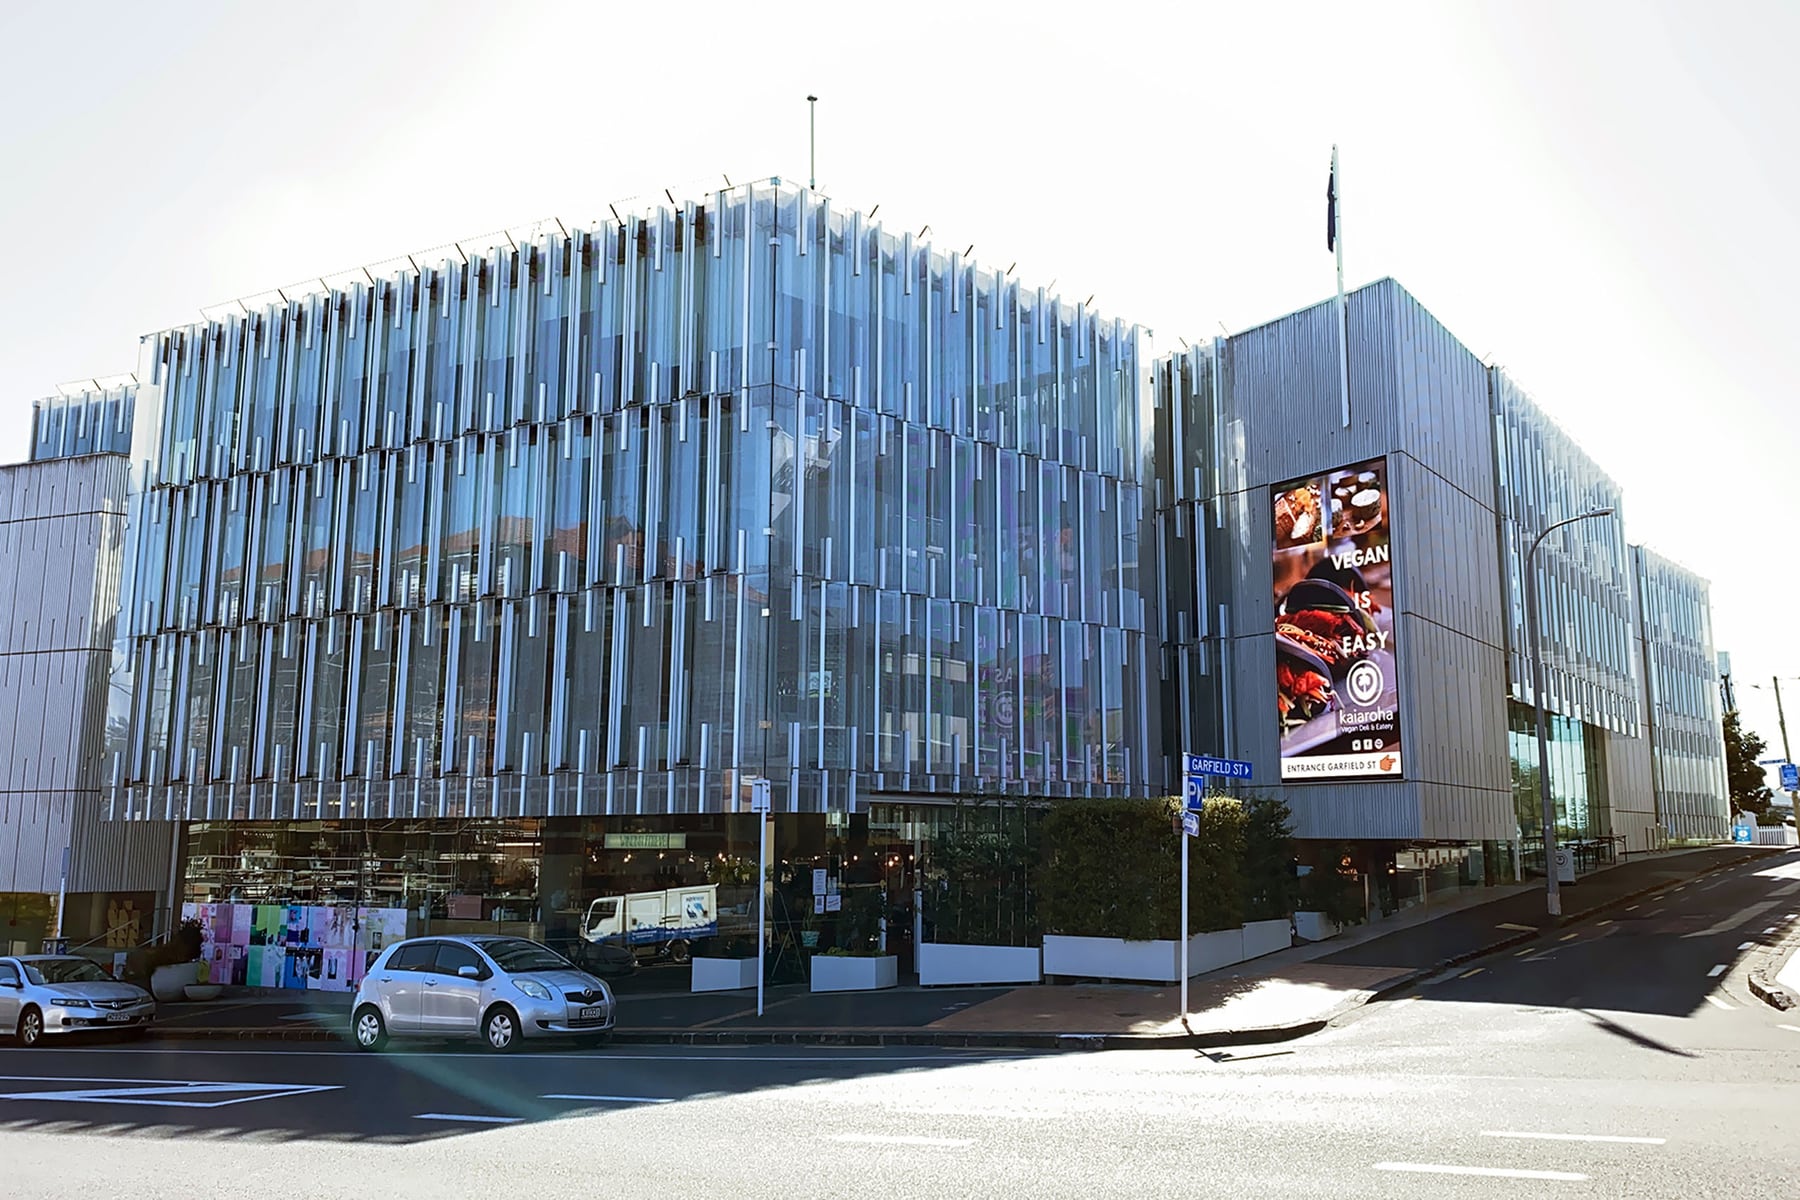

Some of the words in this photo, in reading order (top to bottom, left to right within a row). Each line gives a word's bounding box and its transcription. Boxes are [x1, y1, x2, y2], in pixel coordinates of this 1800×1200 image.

[1330, 544, 1389, 571] VEGAN
[1354, 590, 1371, 610] IS
[1342, 630, 1389, 654] EASY
[1339, 706, 1394, 724] kaiaroha
[1340, 725, 1358, 734] Vegan
[1376, 723, 1394, 731] Eatery
[1192, 758, 1231, 774] GARFIELD
[1233, 763, 1243, 776] ST
[1287, 763, 1325, 773] ENTRANCE
[1327, 761, 1365, 771] GARFIELD
[1367, 760, 1377, 769] ST
[1188, 781, 1197, 803] P
